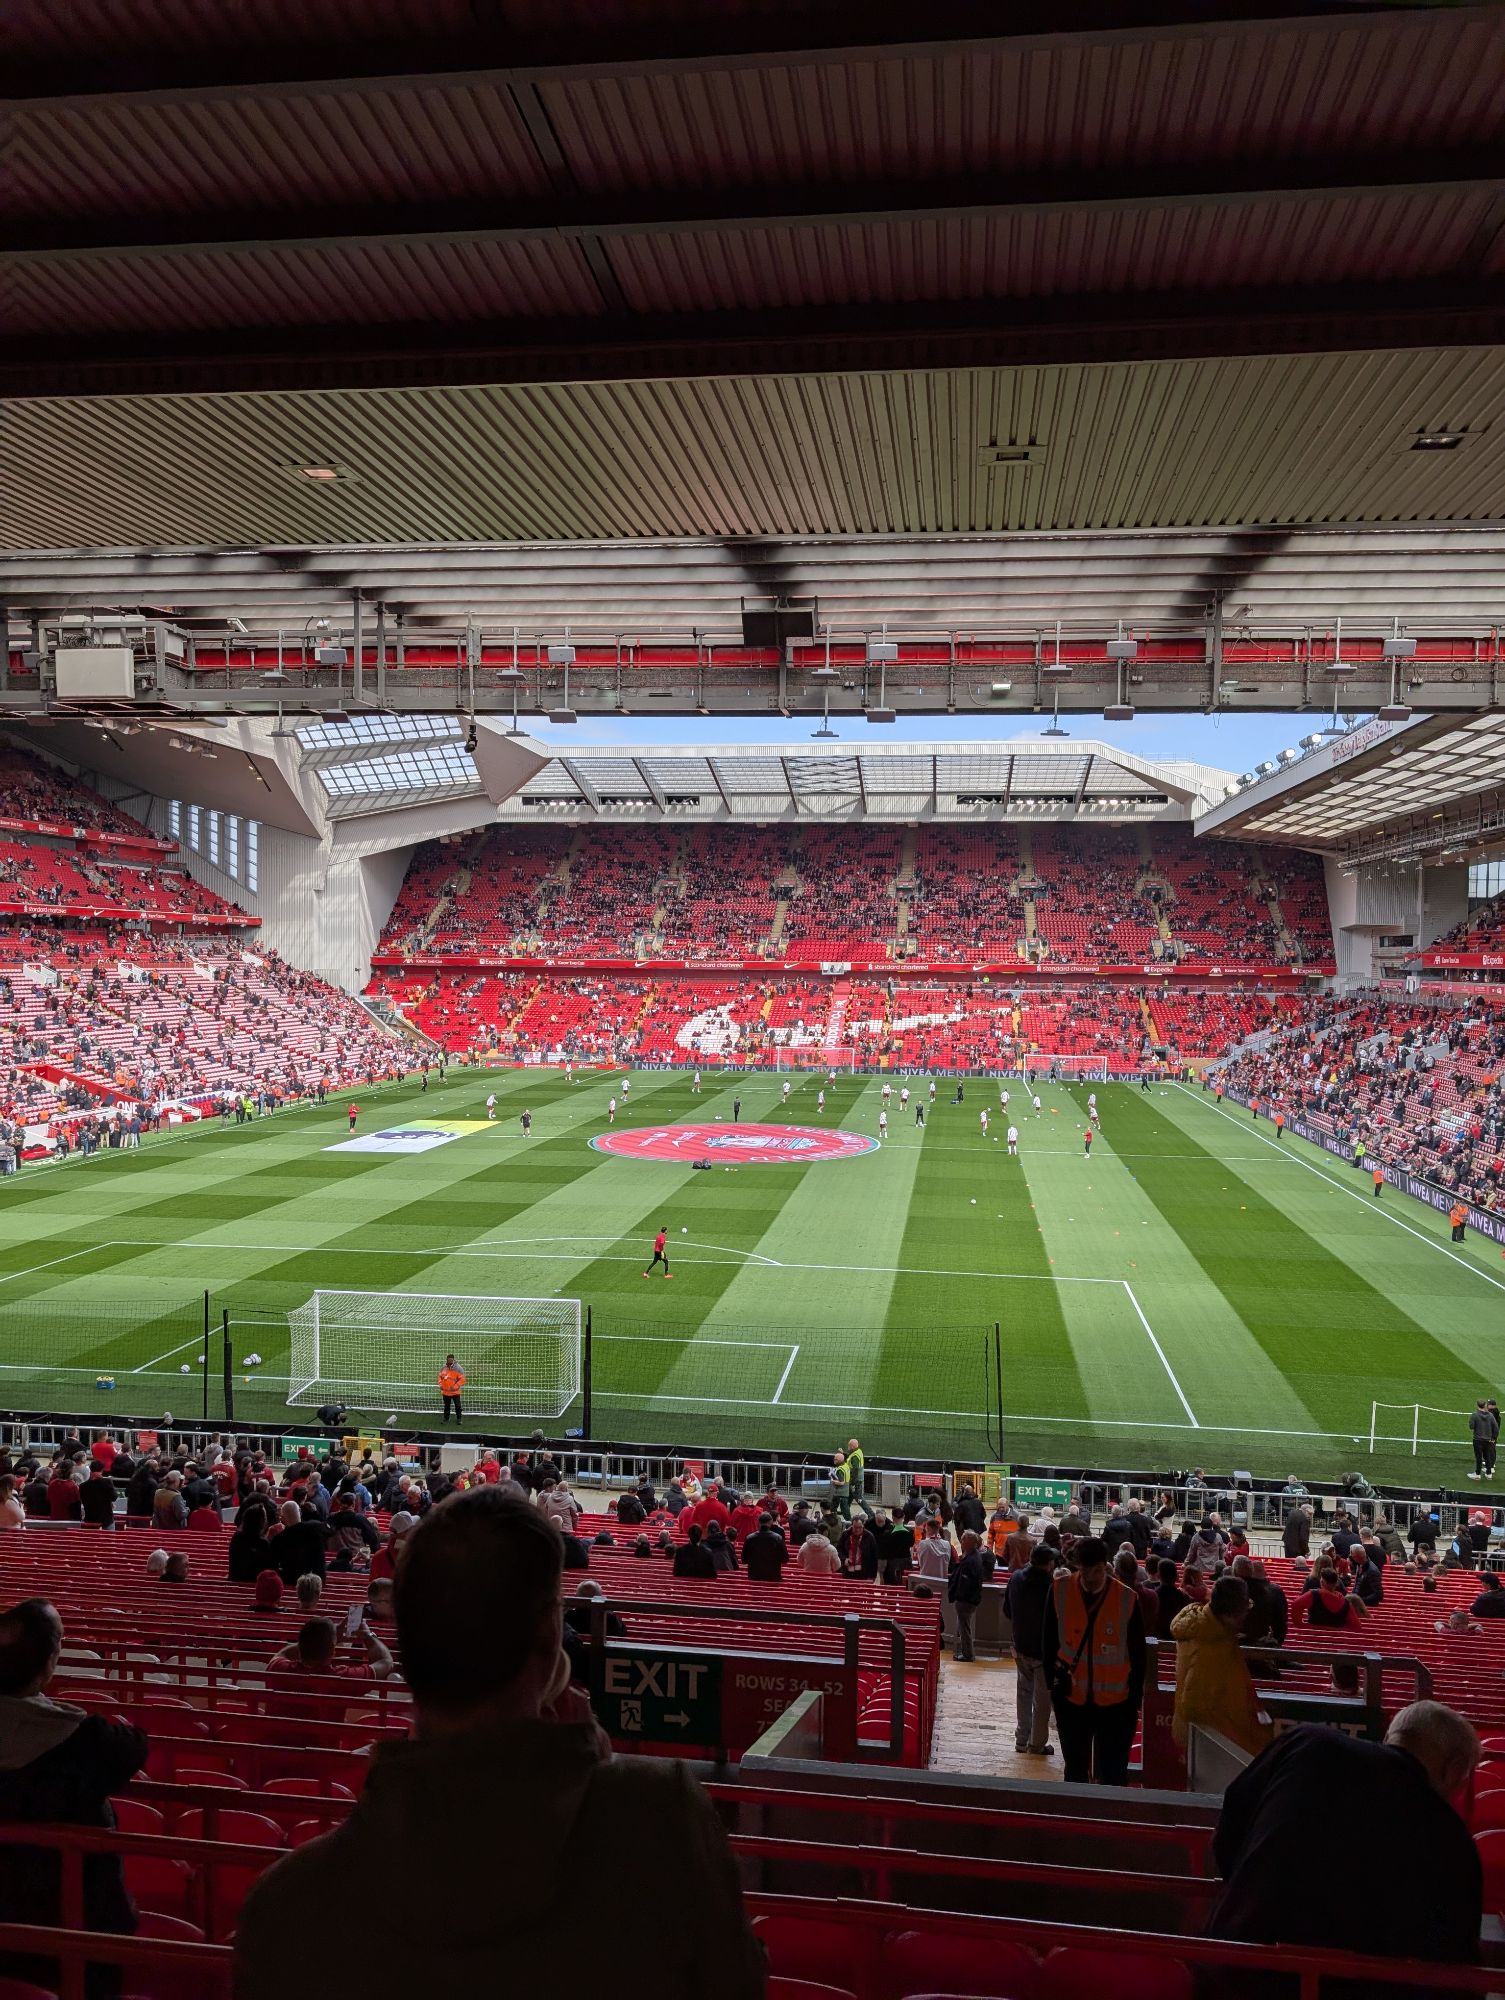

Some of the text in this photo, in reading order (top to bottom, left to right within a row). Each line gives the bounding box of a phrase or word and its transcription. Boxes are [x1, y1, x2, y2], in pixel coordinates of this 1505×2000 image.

[1410, 1180, 1430, 1202] NIVEA
[1469, 1210, 1494, 1238] NIVEA
[284, 1444, 304, 1454] EXI
[1018, 1486, 1042, 1496] EXIT
[604, 1657, 708, 1699] EXIT
[736, 1674, 785, 1692] ROWS
[788, 1678, 808, 1692] 34
[823, 1681, 844, 1696] 52
